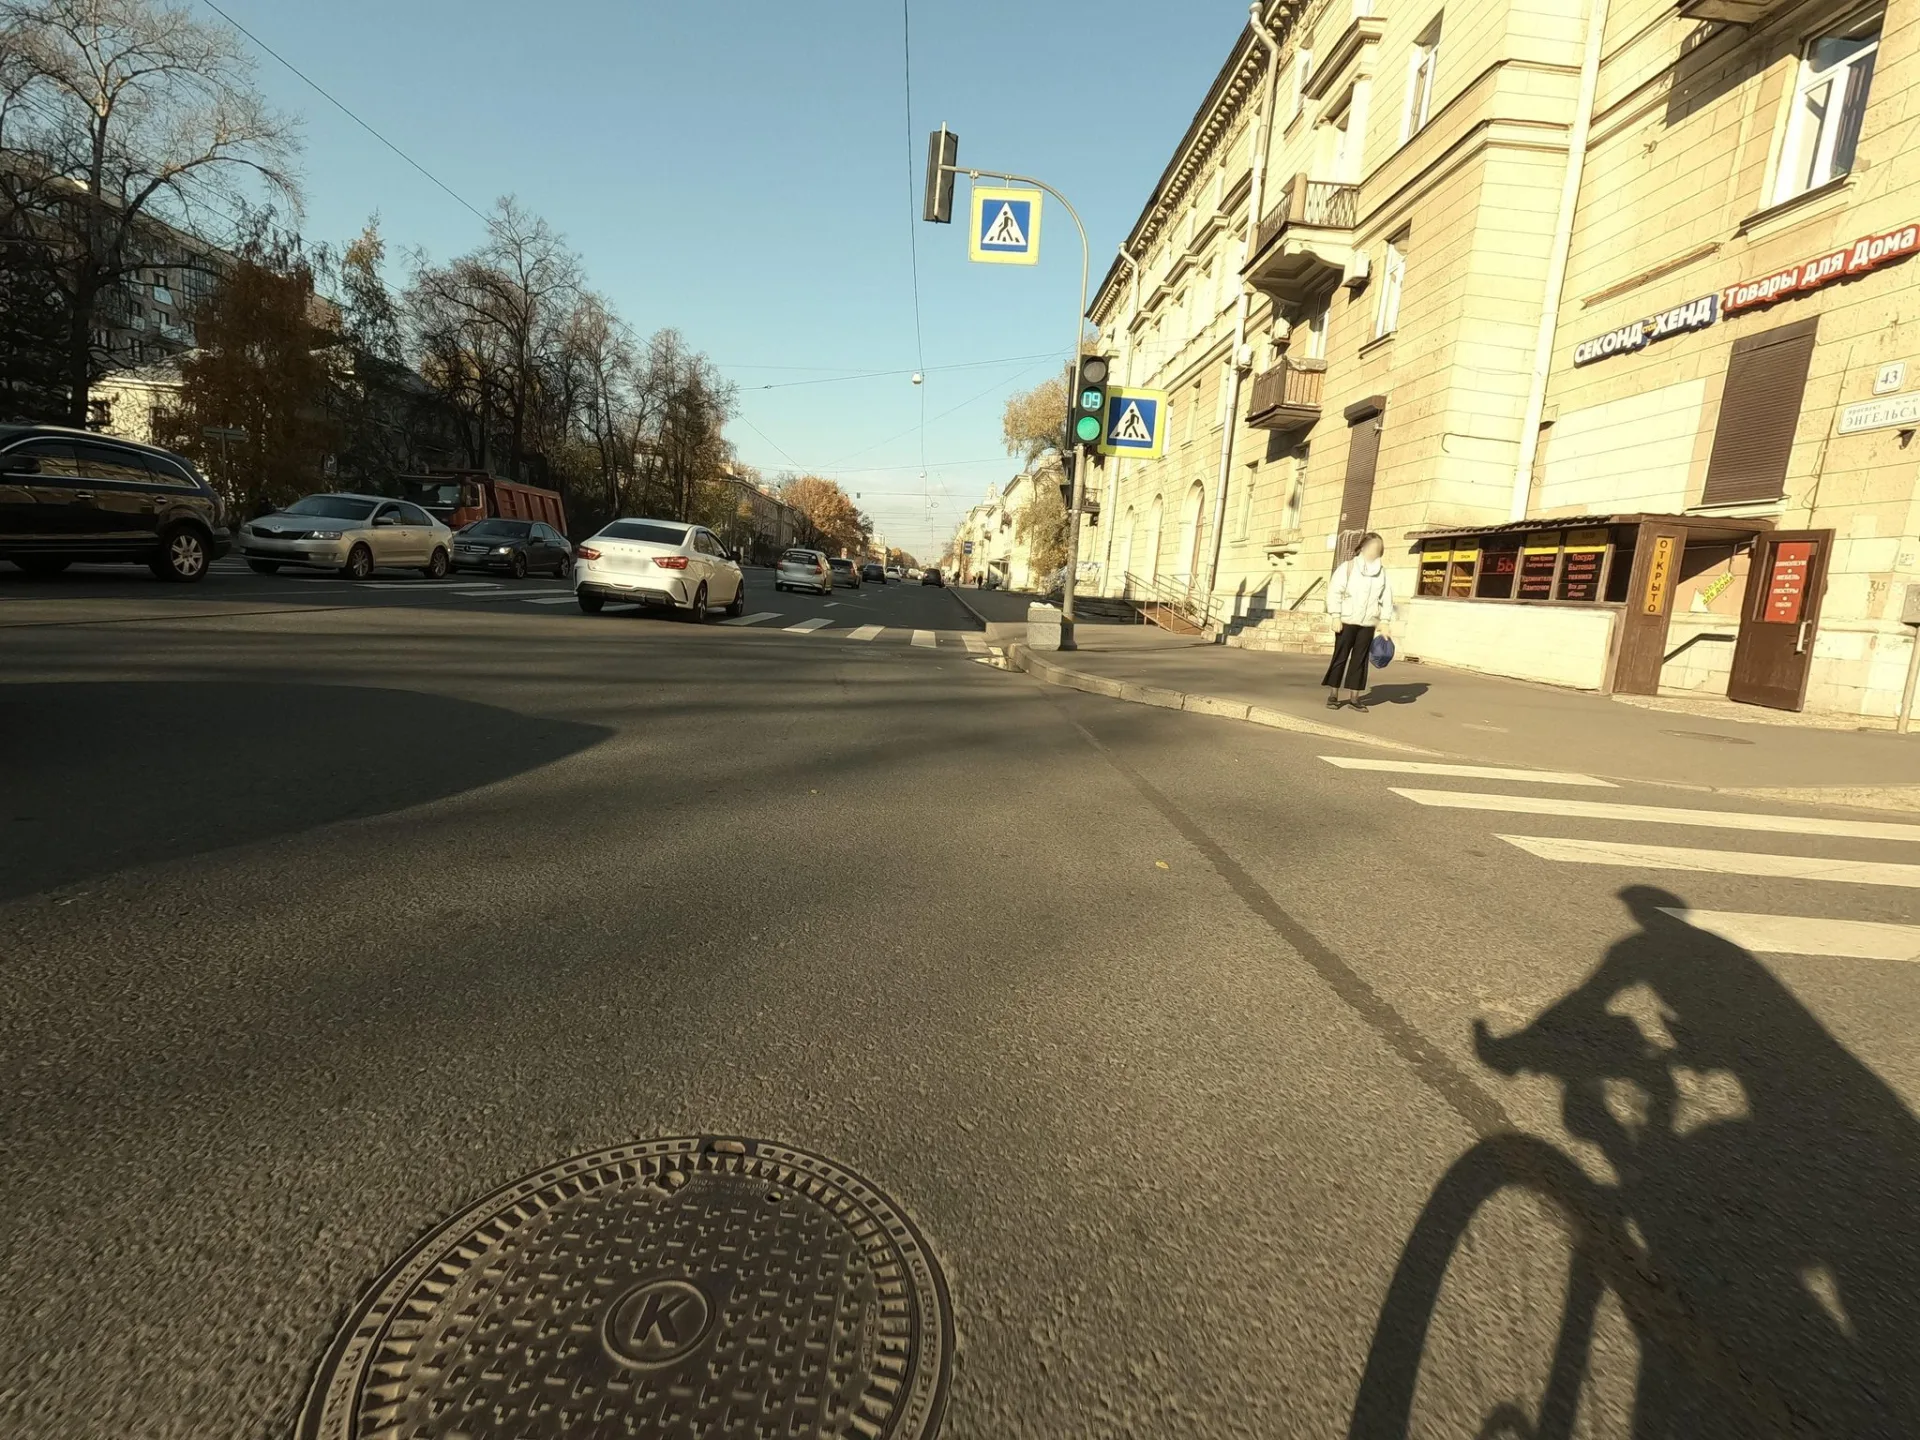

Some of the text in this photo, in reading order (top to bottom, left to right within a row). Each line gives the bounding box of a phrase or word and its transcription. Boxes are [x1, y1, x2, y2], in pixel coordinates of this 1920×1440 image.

[1725, 227, 1917, 309] Товары для Дома
[1574, 296, 1712, 363] СЕКОНД ХЕНД
[1880, 370, 1898, 385] 43
[1082, 391, 1101, 409] 09
[1845, 406, 1918, 428] ЭНГЕЛЬСА
[1647, 539, 1668, 613] ОТКРЫТО
